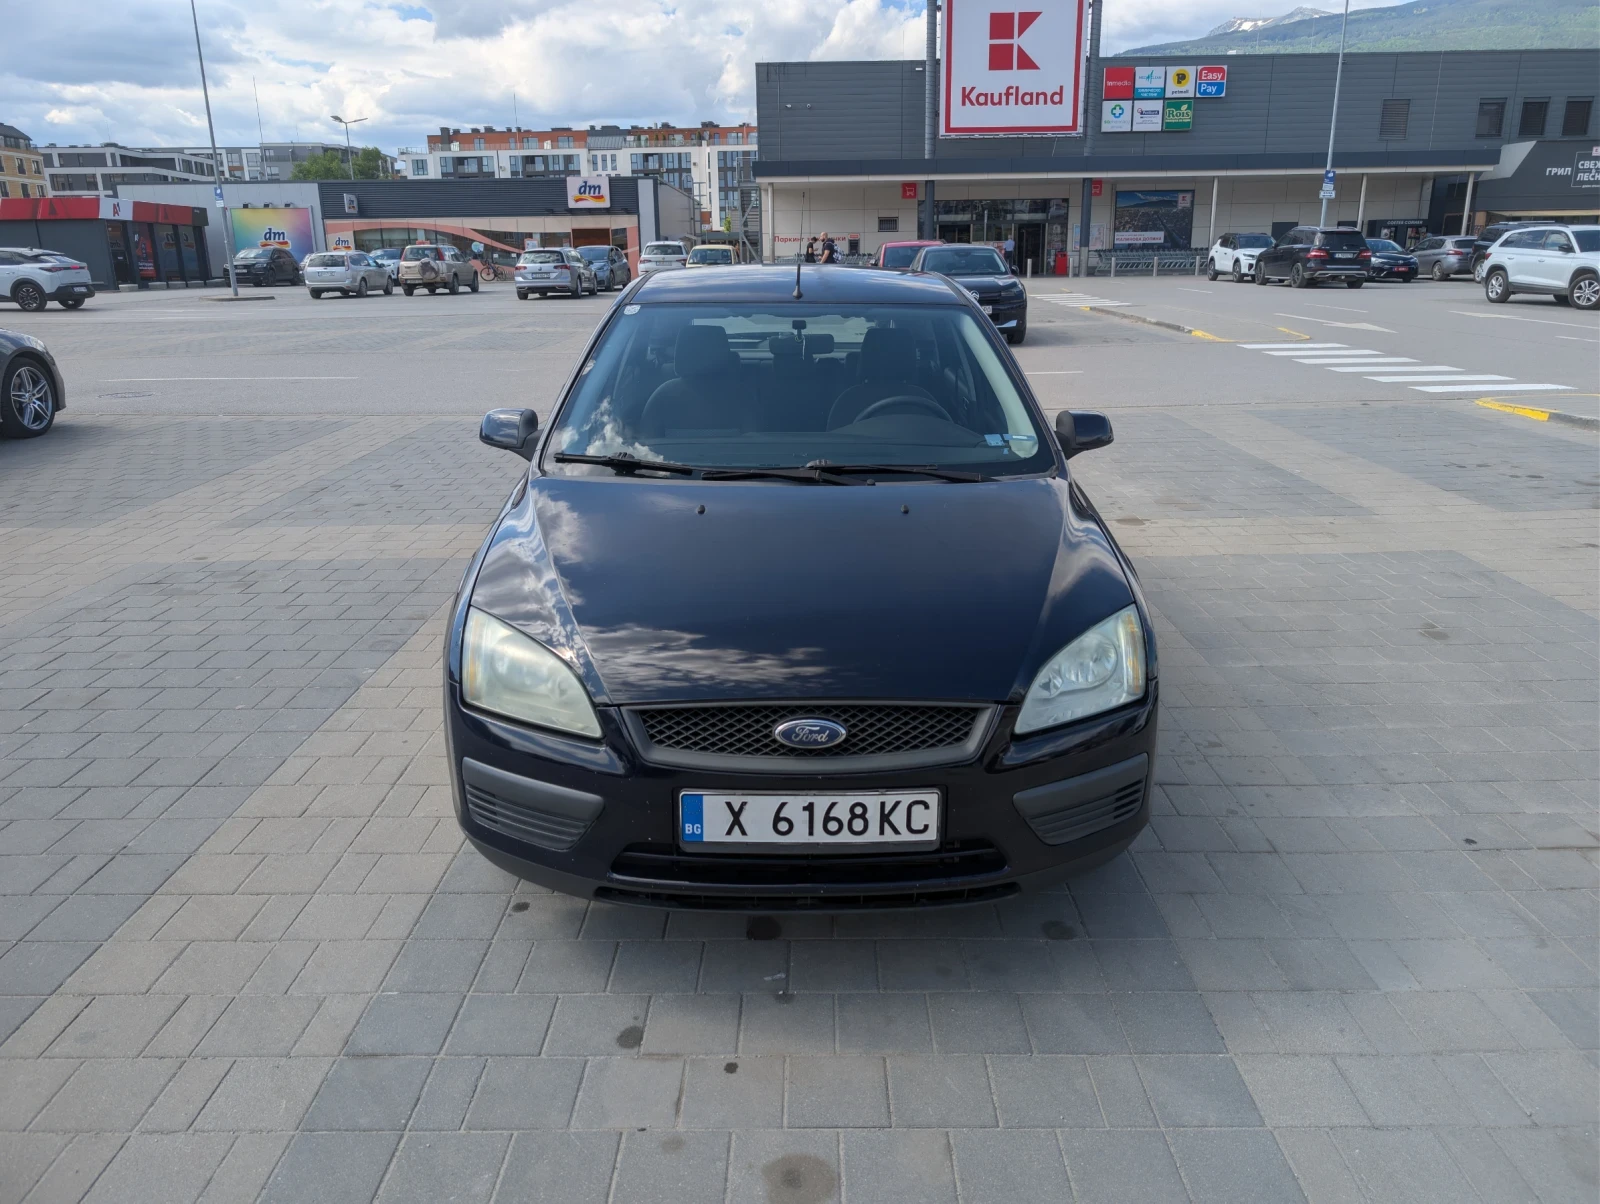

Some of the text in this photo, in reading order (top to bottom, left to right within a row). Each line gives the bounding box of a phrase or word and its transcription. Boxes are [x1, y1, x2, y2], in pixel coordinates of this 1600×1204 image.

[1201, 69, 1223, 80] Easy
[1200, 83, 1217, 94] Pay
[961, 85, 1064, 107] Kaufland
[1545, 167, 1572, 176] ГРИЛ
[578, 181, 602, 195] dm
[263, 228, 286, 241] dm
[335, 237, 349, 246] dm
[792, 726, 829, 742] Ford
[724, 801, 748, 836] X
[684, 823, 702, 834] BG
